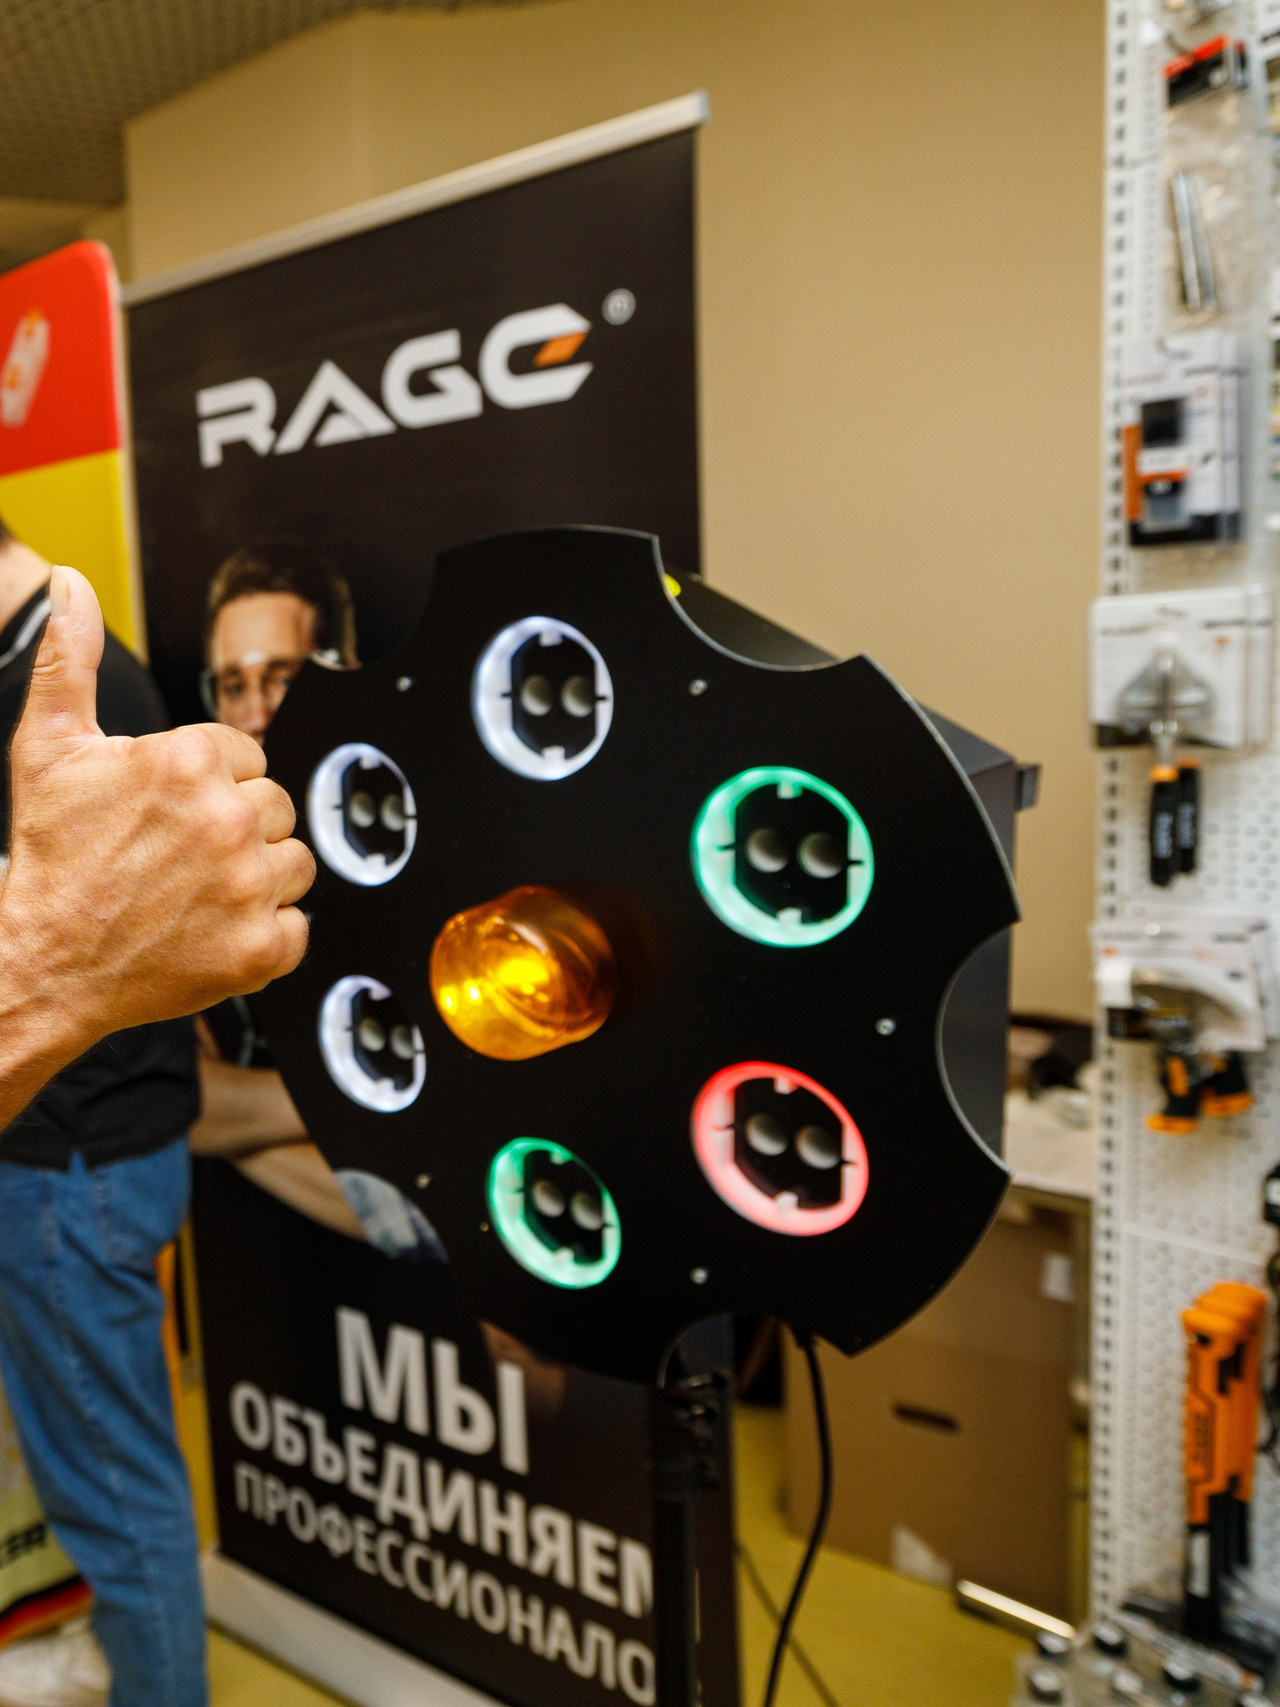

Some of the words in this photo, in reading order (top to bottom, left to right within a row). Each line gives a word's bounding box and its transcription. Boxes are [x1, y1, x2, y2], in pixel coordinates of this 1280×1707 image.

[194, 302, 595, 469] RAGE
[335, 1304, 531, 1476] МЫ
[233, 1462, 657, 1707] ПРОФЕССИОНАЛО
